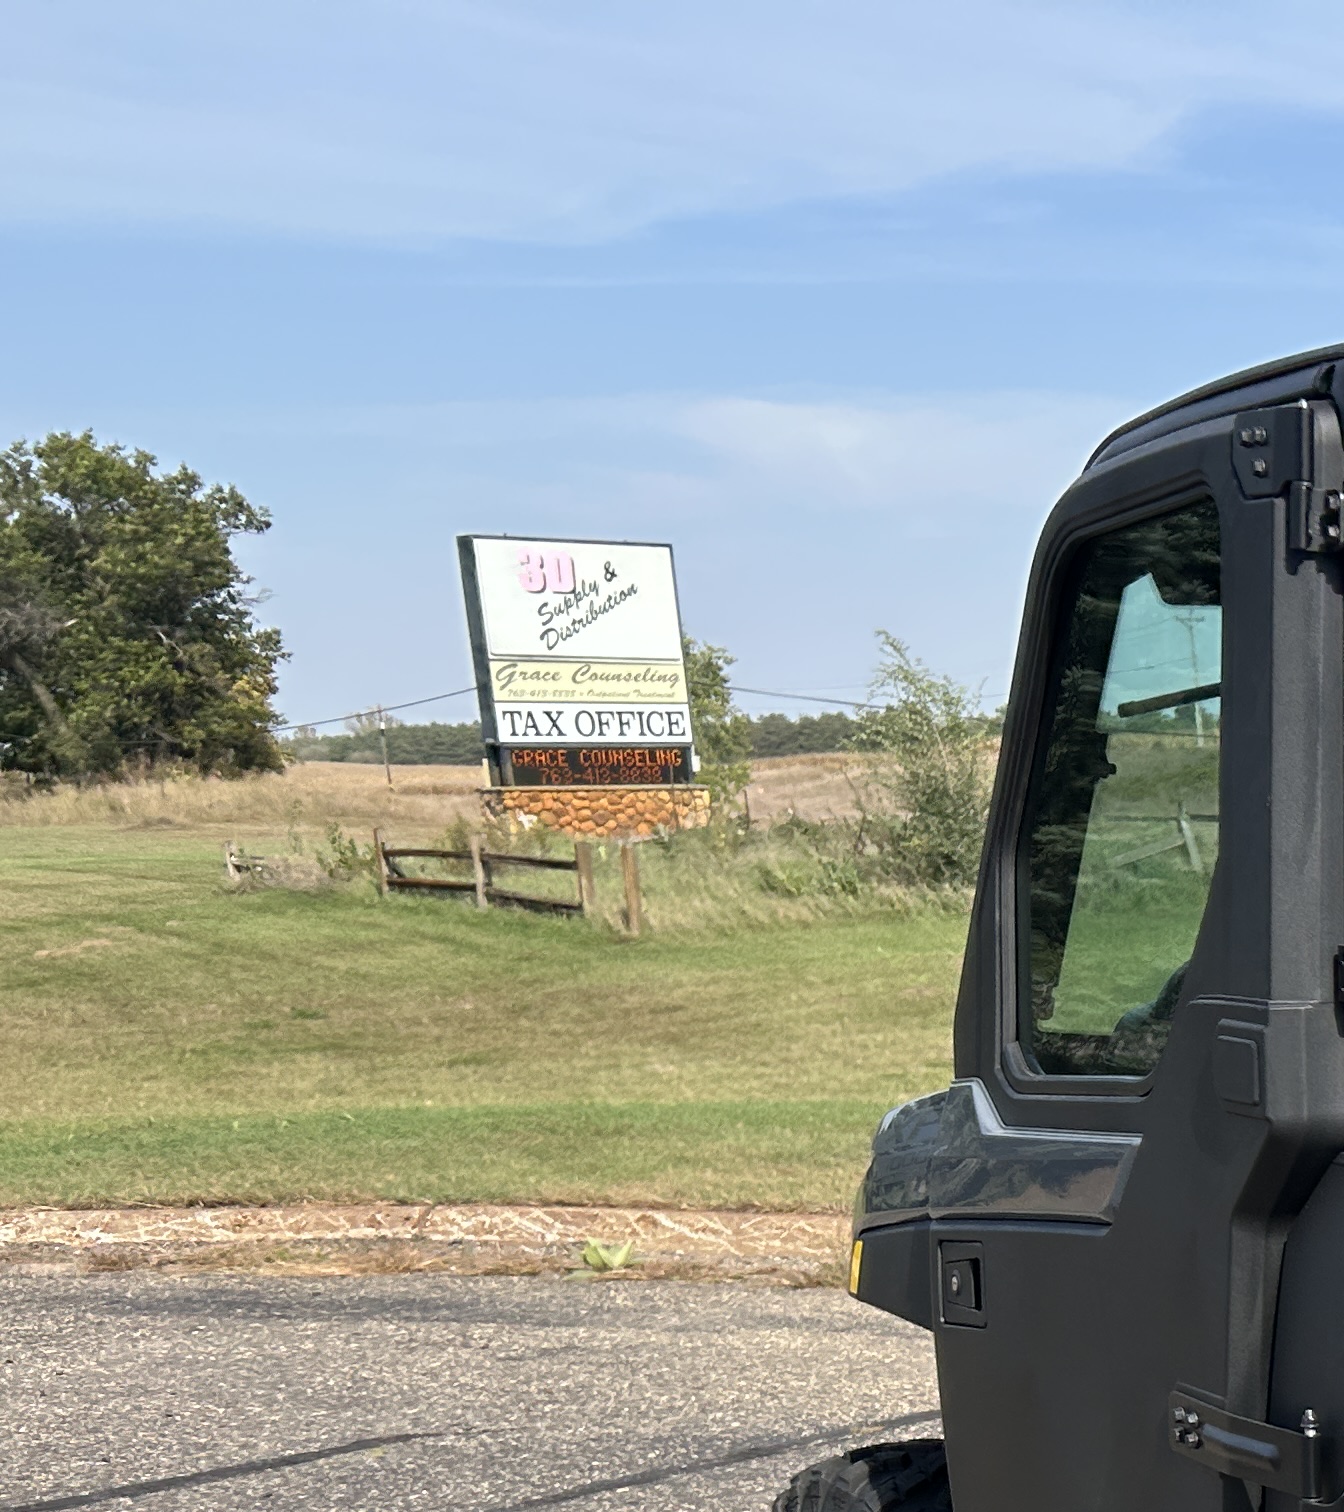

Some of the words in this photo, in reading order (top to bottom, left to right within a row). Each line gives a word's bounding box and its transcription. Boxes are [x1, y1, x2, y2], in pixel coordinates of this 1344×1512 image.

[538, 580, 599, 626] Supply
[603, 561, 618, 582] &
[540, 583, 638, 650] Distribution
[495, 663, 562, 691] Grace
[571, 664, 680, 689] Counseling
[502, 710, 567, 737] TAX
[574, 710, 686, 737] OFFICE
[511, 748, 569, 767] GRACE
[580, 748, 682, 768] COUNSELING
[540, 767, 663, 785] 763-413-8838
